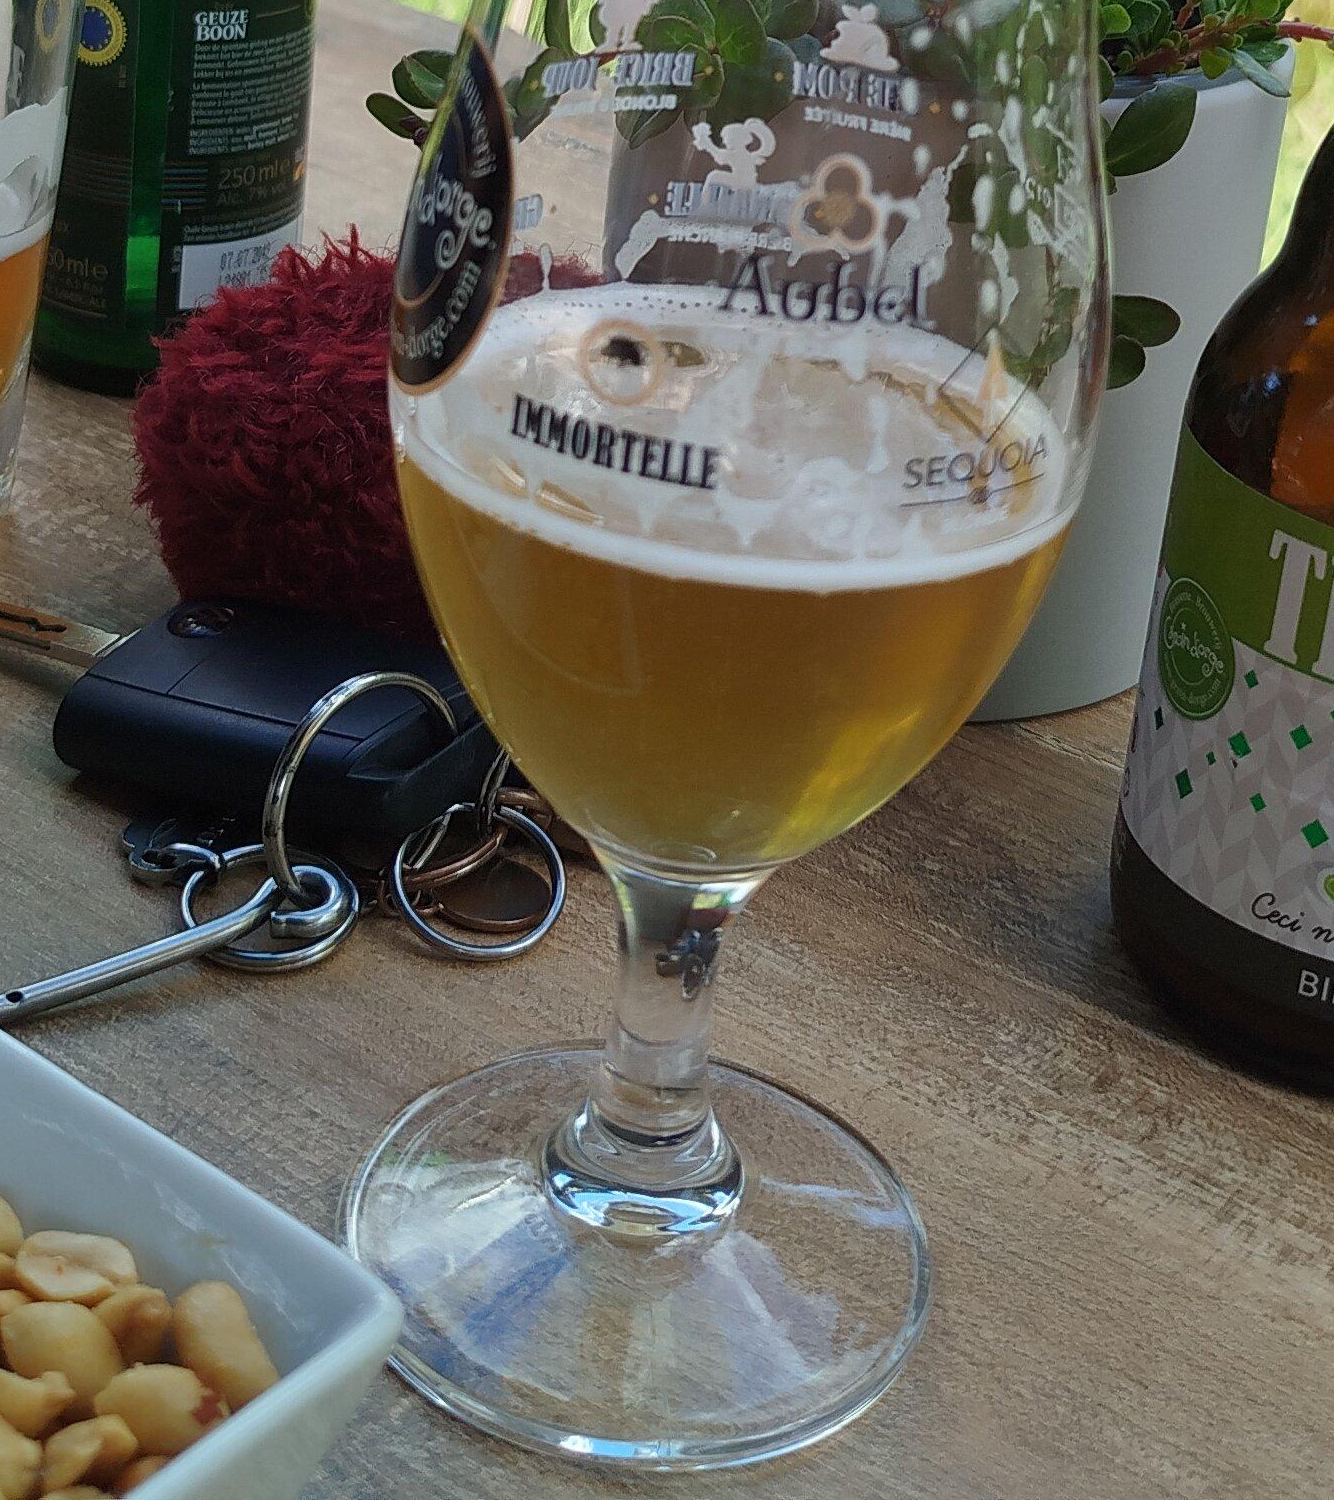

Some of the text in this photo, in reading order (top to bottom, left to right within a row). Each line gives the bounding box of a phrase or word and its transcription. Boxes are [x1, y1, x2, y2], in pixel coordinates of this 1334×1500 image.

[194, 8, 249, 26] GEUZE
[195, 24, 247, 42] BOON
[218, 164, 256, 190] 250
[510, 393, 724, 491] IMMORTELLE
[902, 432, 1048, 490] SEQUOIA
[1251, 892, 1302, 933] Ceci
